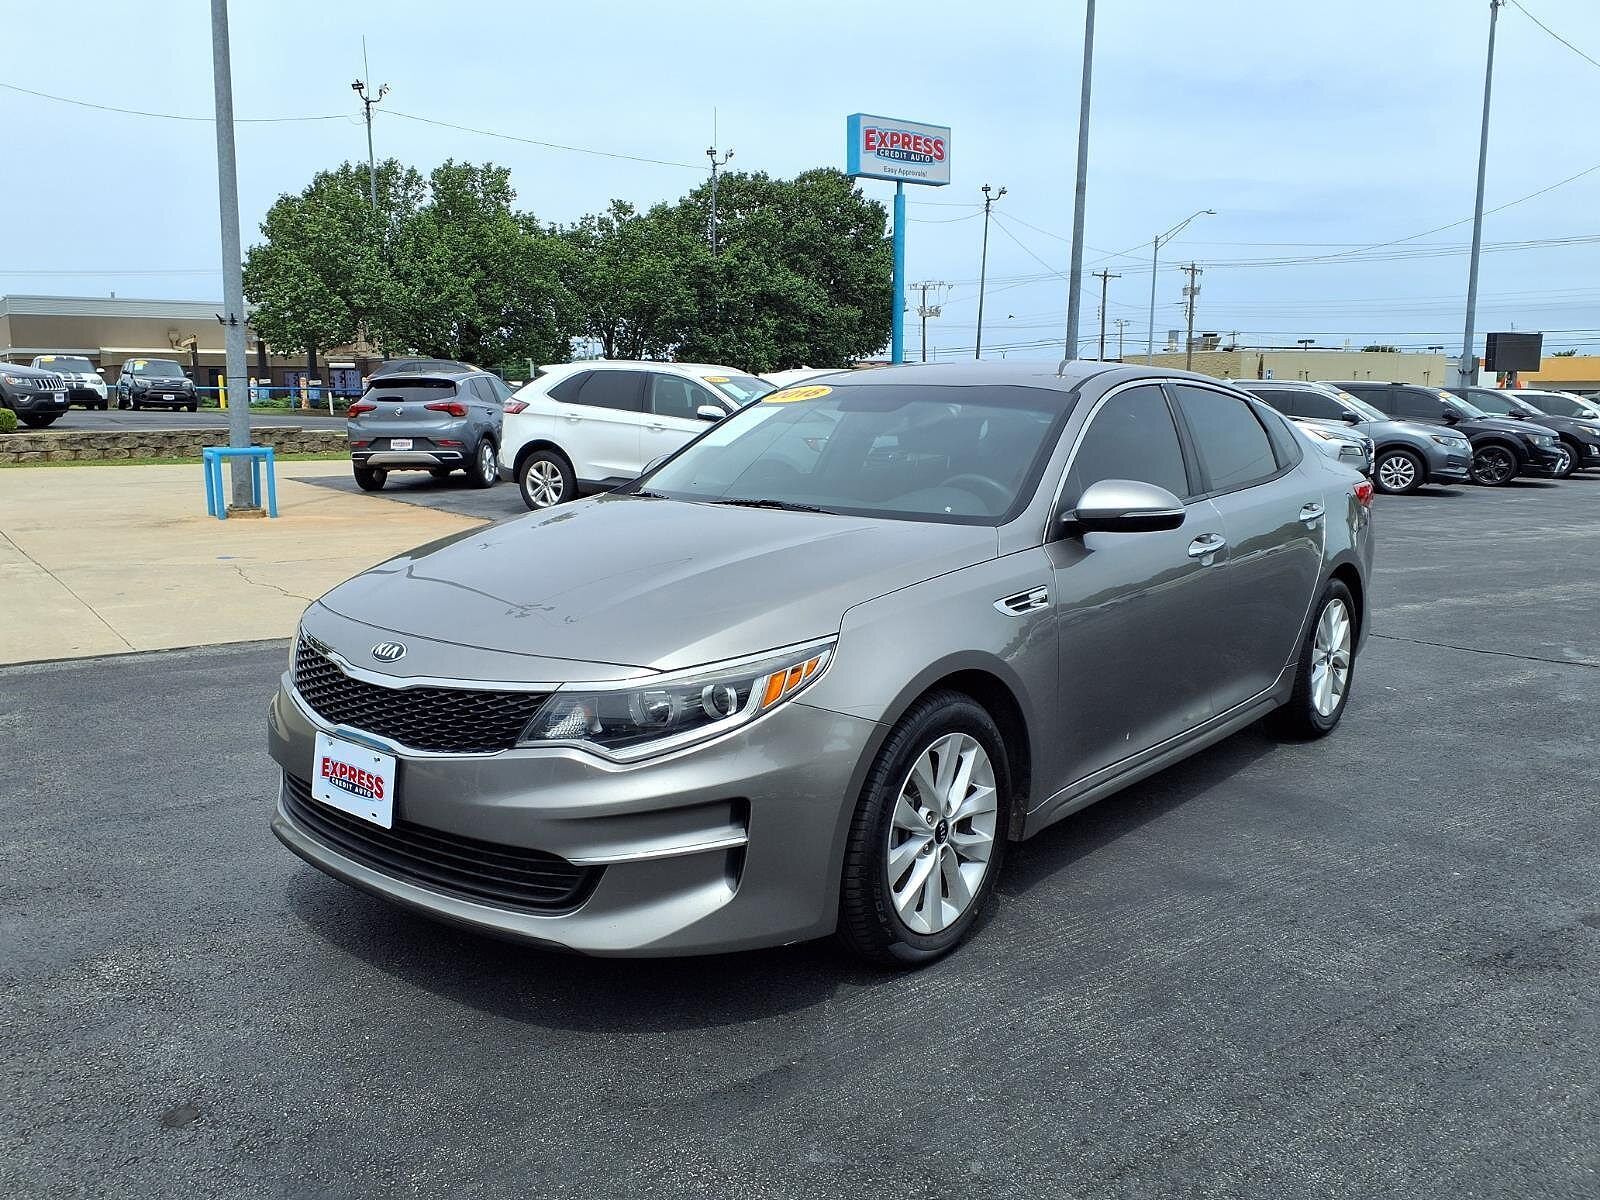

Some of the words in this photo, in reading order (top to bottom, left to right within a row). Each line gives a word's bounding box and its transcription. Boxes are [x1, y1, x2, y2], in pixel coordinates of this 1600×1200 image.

[865, 128, 945, 161] EXPRESS
[879, 149, 907, 160] CREDIT
[910, 154, 930, 162] AUTO
[883, 165, 897, 175] Easy
[322, 757, 384, 800] EXPRESS
[331, 776, 353, 791] CREDIT
[354, 787, 372, 798] AUTO
